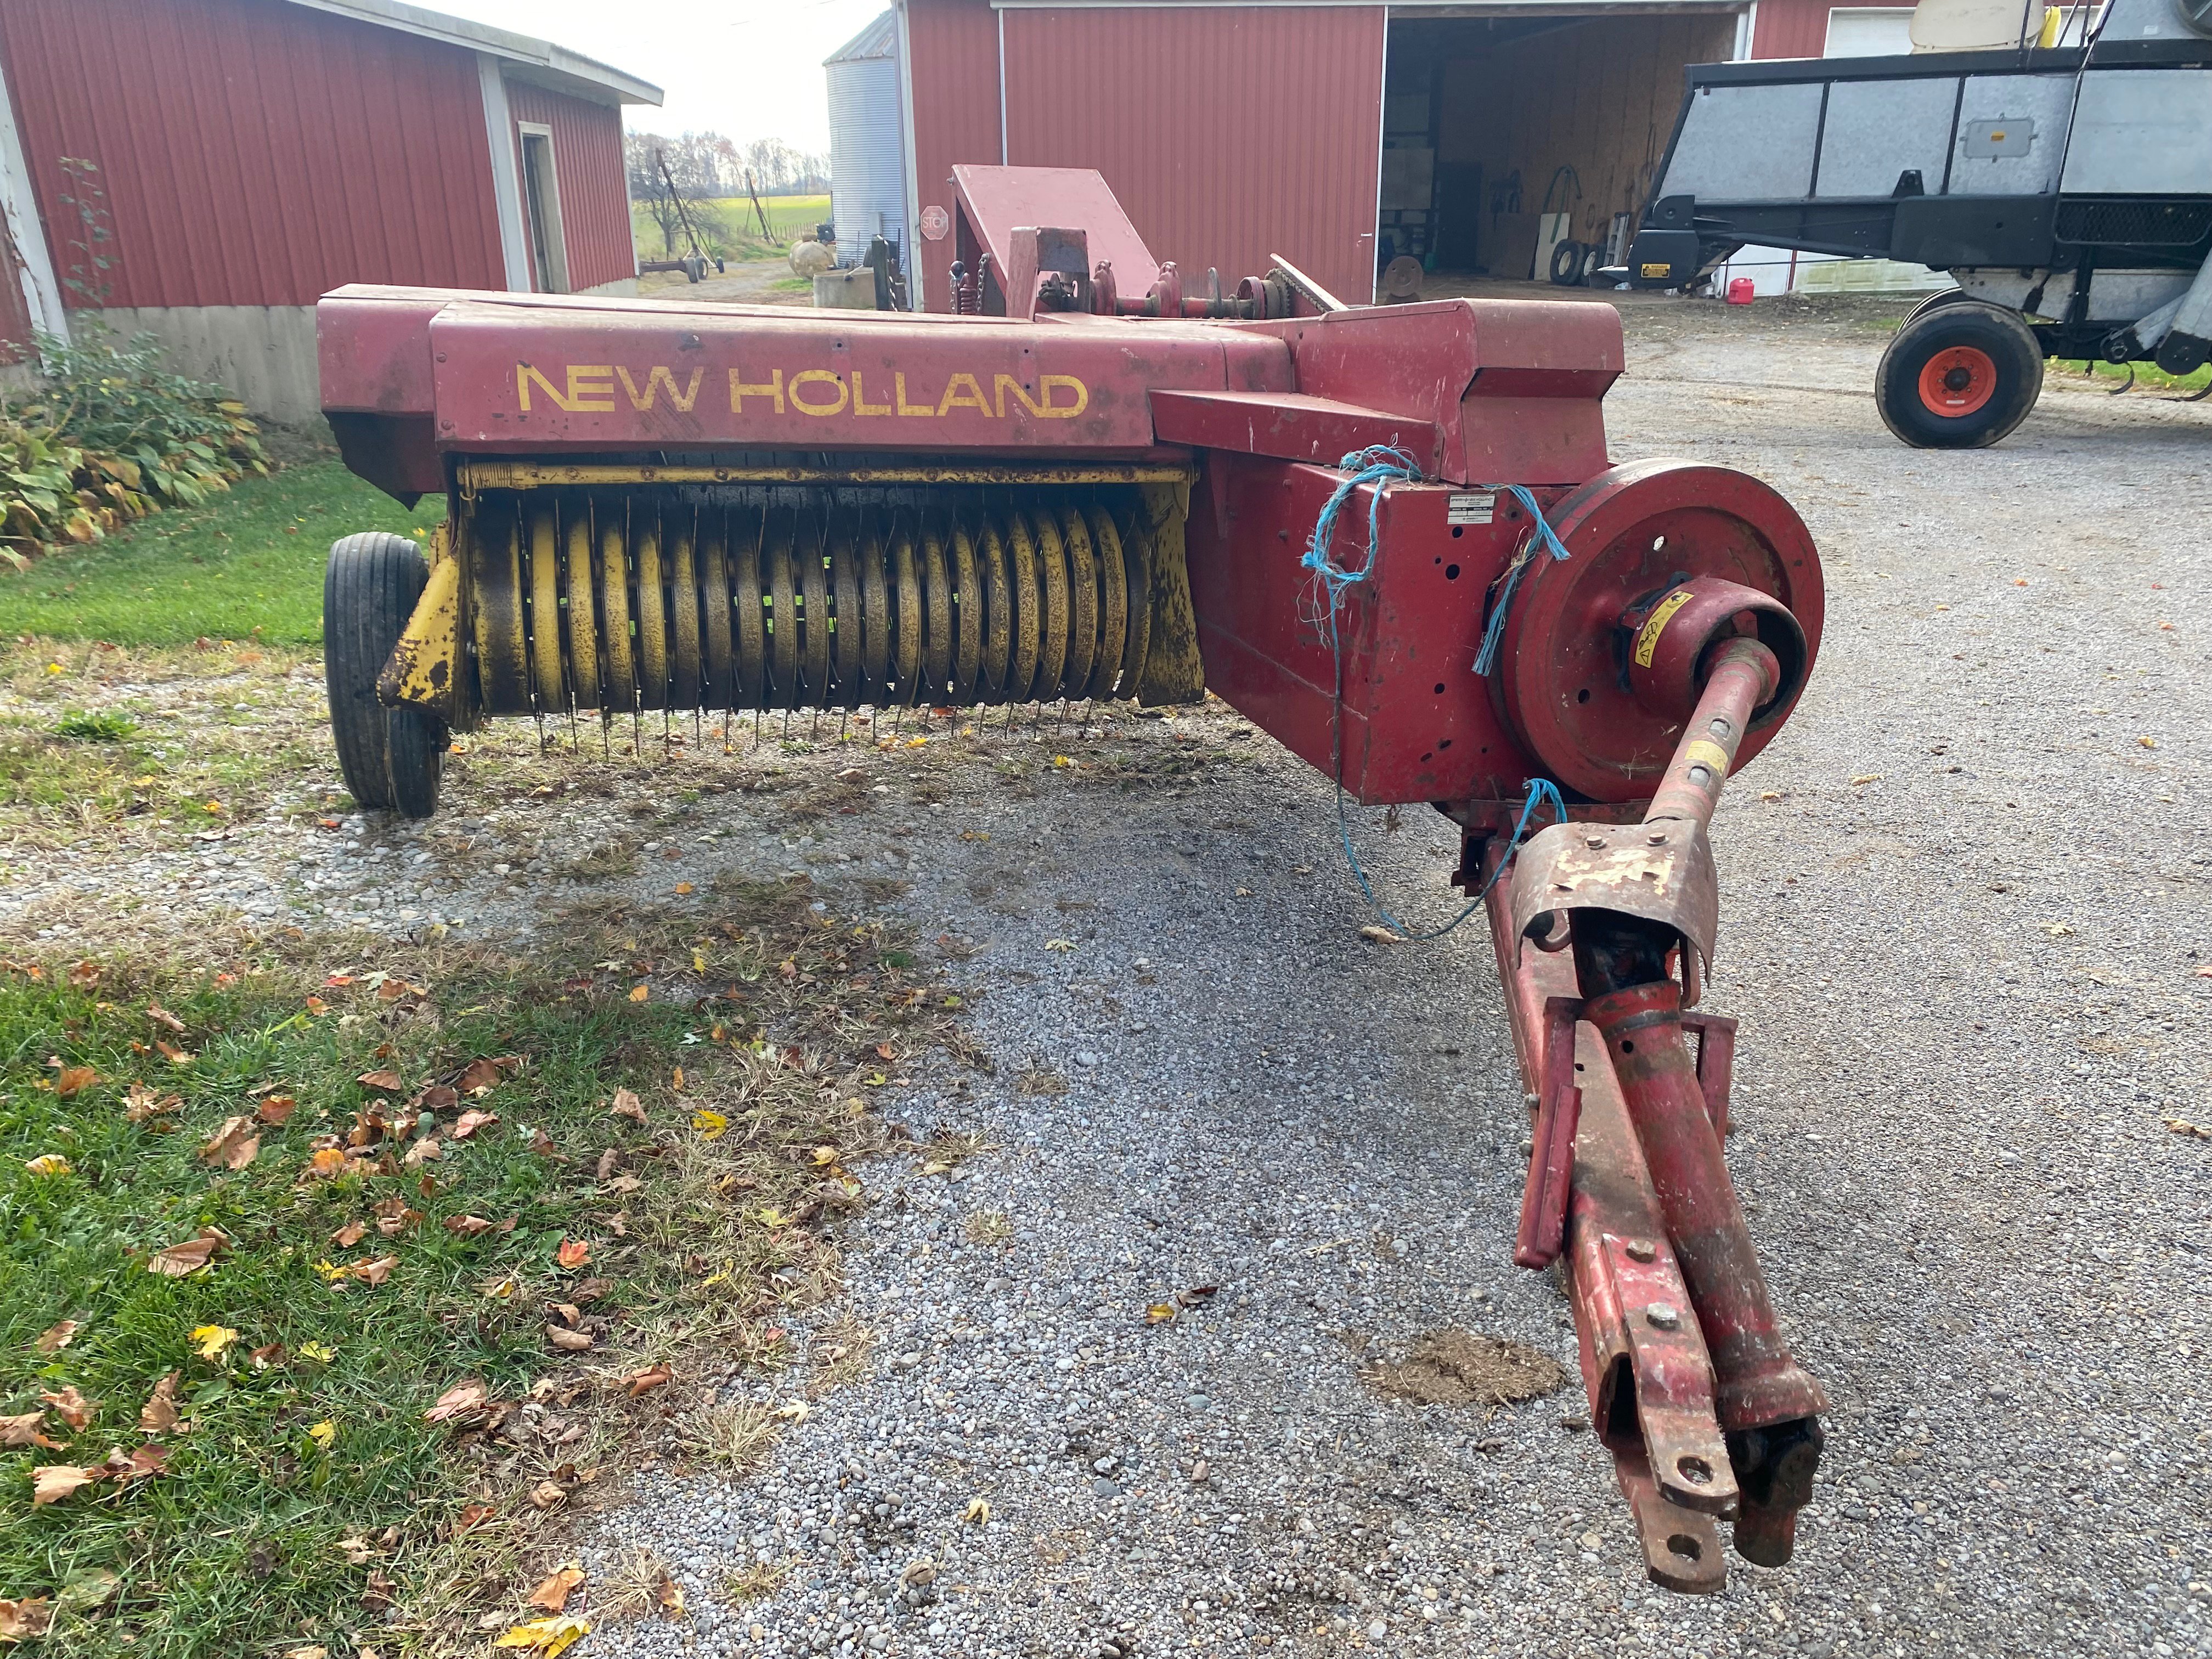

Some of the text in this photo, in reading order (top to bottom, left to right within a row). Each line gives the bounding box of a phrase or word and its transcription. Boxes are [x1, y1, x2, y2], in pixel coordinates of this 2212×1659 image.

[923, 217, 946, 228] STOP
[516, 364, 1088, 419] NEW HOLLAND
